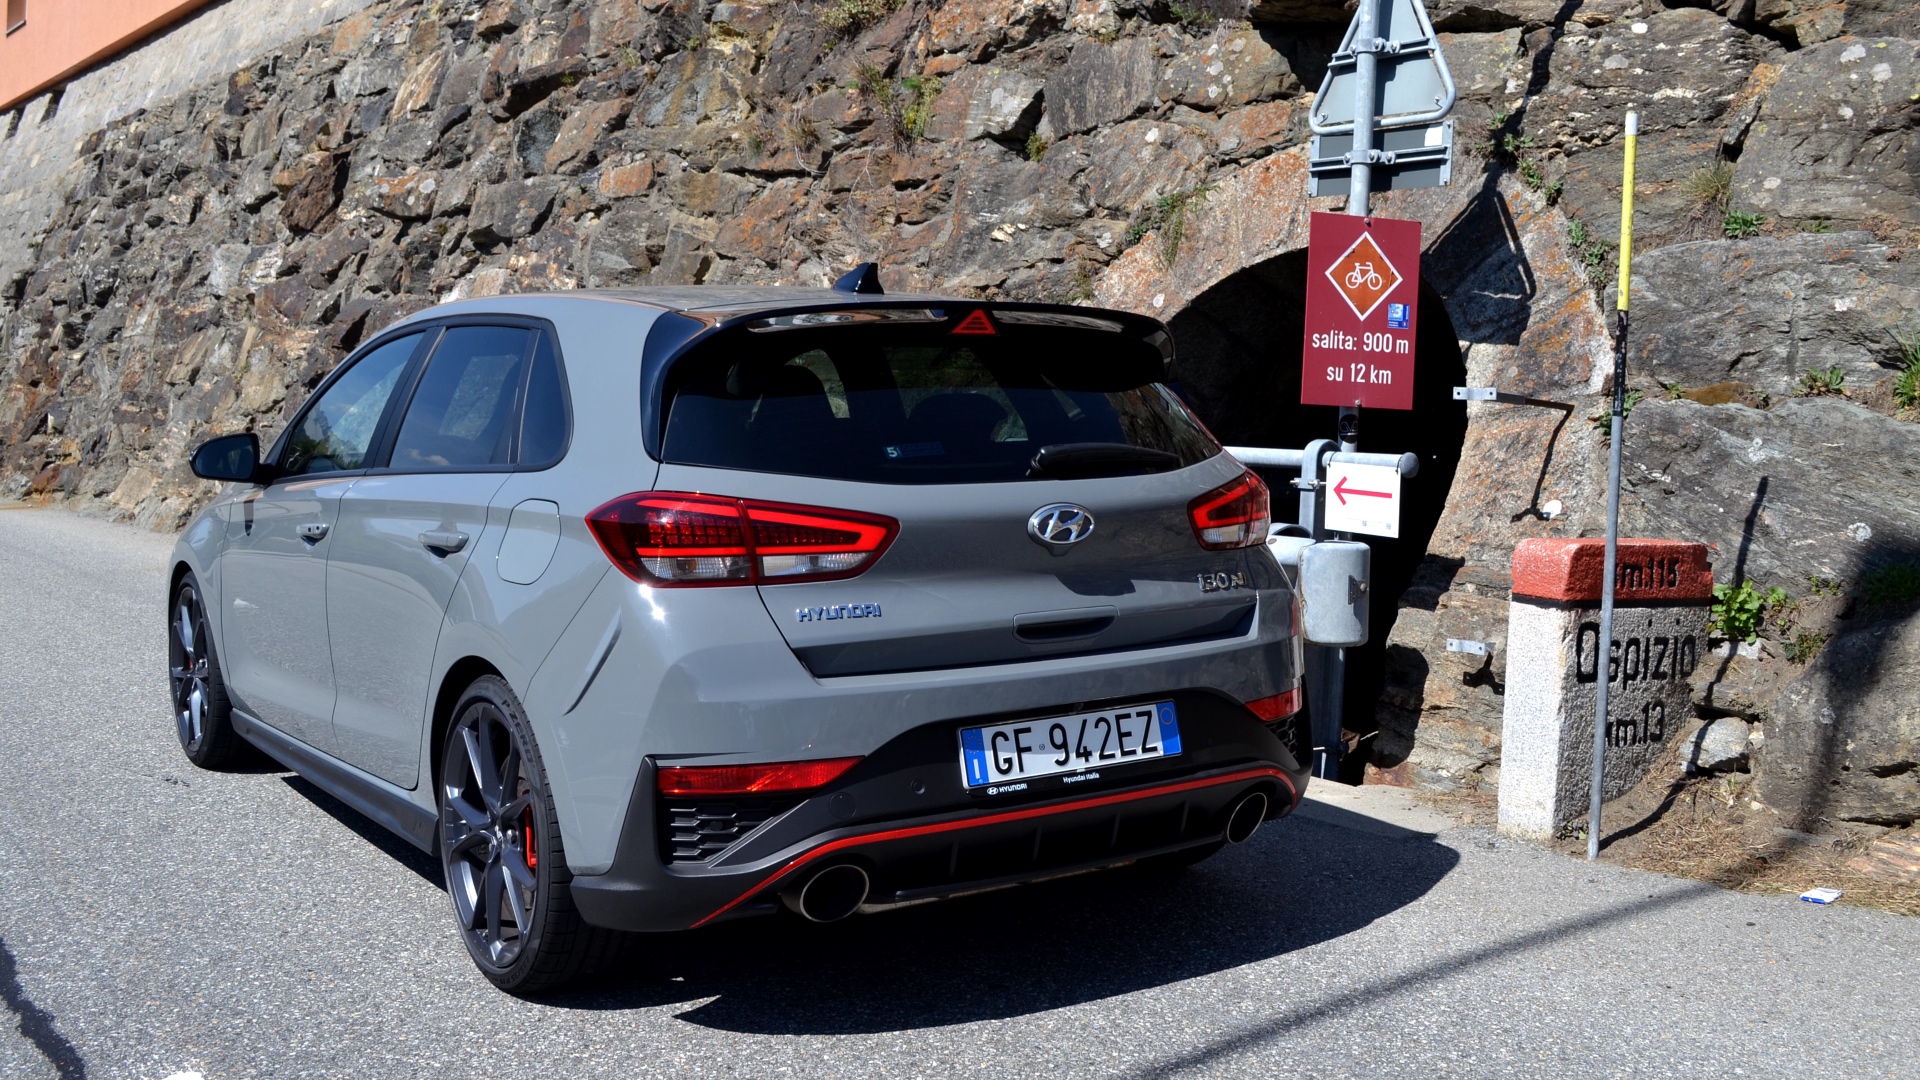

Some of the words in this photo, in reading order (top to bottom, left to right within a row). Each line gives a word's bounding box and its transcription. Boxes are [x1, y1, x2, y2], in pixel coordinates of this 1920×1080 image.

[1312, 330, 1357, 351] salita:
[1363, 332, 1393, 353] 900
[1396, 338, 1409, 354] m
[1326, 366, 1343, 382] su
[1350, 363, 1366, 383] 12
[1370, 364, 1392, 385] km
[886, 446, 898, 458] 5
[1231, 572, 1246, 587] N
[796, 602, 882, 622] HYUNDAI
[1576, 618, 1697, 690] Ospizio
[509, 710, 534, 763] ZERO
[991, 726, 1033, 776] GF
[1048, 709, 1159, 767] 942EZ
[998, 783, 1028, 793] HYUNDAI
[1062, 775, 1086, 784] Hyundai
[1086, 772, 1100, 780] Italia
